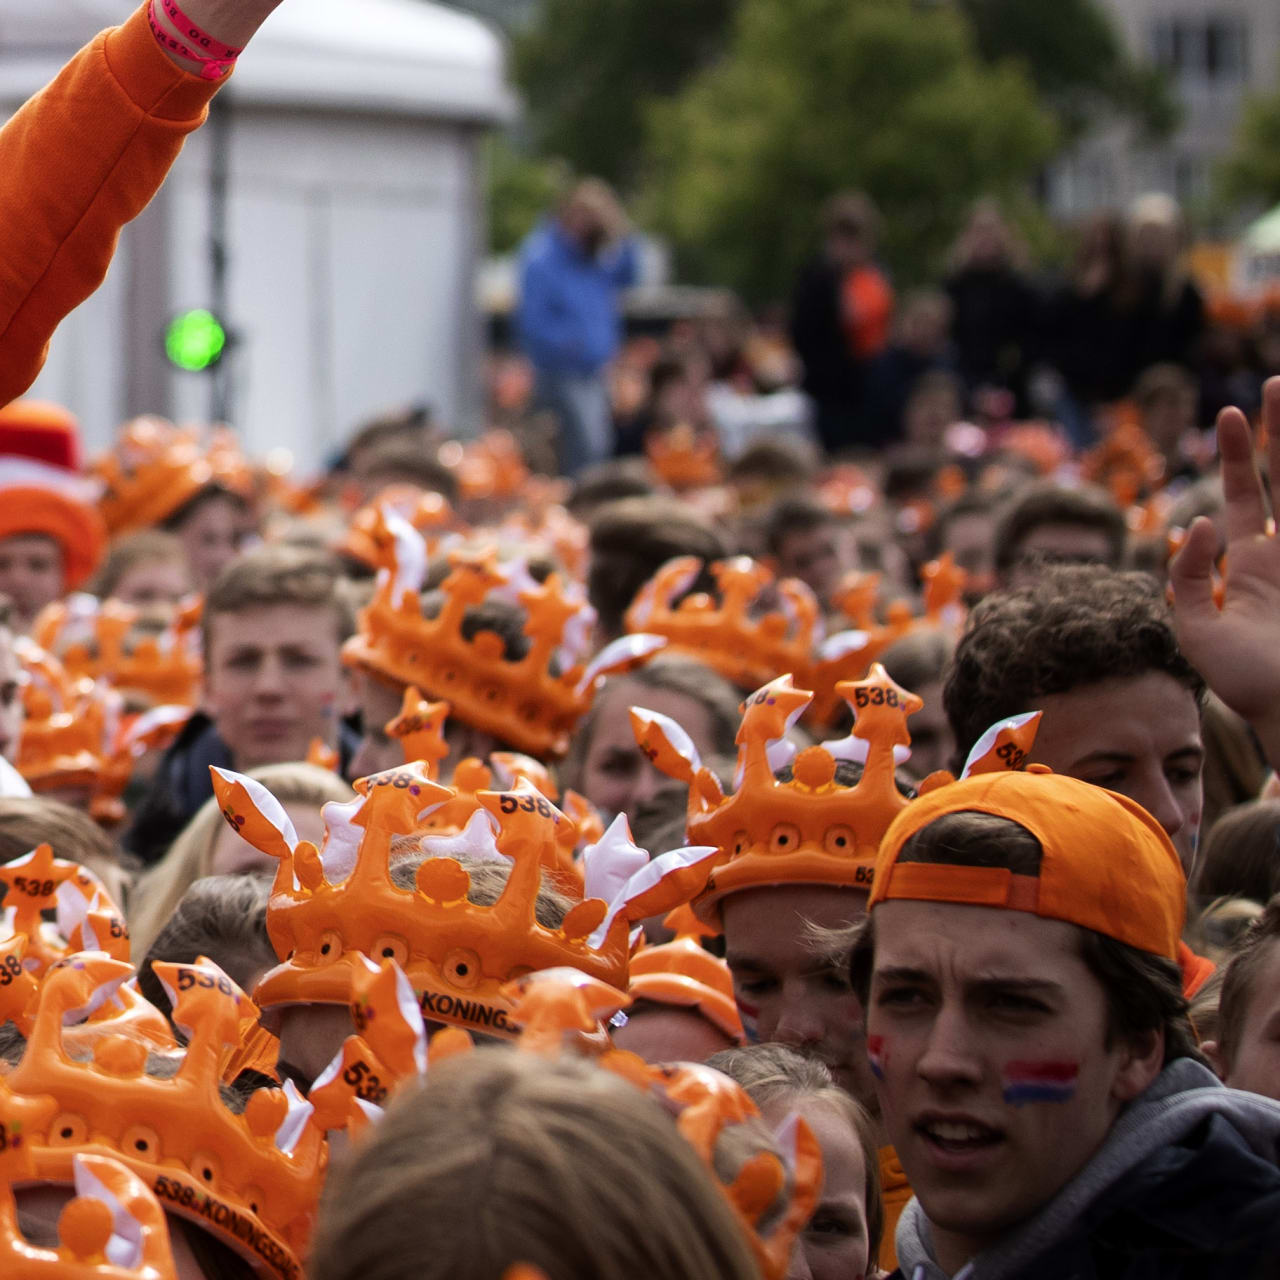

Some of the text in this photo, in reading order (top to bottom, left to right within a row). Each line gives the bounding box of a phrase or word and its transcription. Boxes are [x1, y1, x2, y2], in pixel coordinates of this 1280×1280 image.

[854, 686, 899, 709] 538
[499, 793, 551, 819] 538
[13, 876, 55, 897] 538
[177, 969, 233, 996] 538
[421, 990, 523, 1035] KONING
